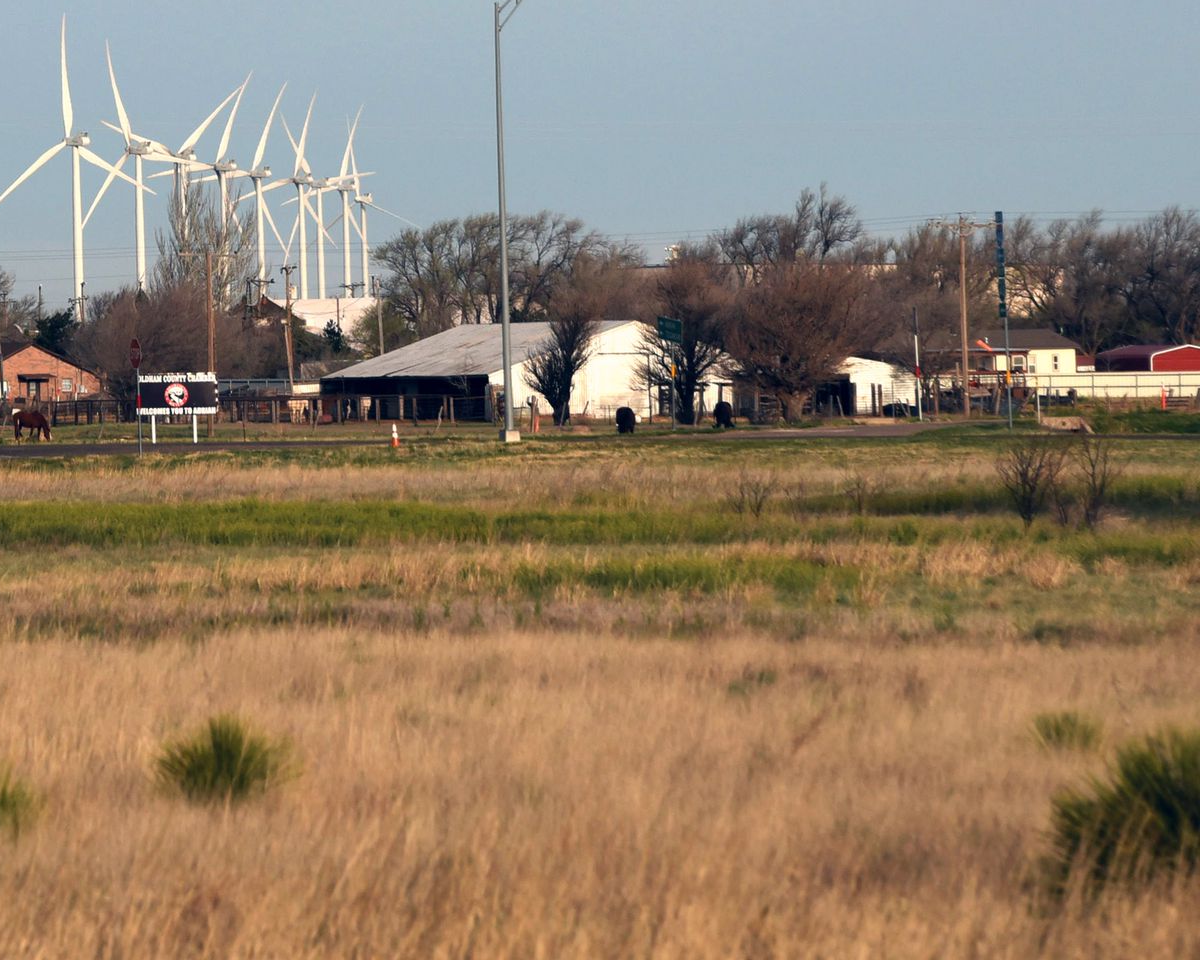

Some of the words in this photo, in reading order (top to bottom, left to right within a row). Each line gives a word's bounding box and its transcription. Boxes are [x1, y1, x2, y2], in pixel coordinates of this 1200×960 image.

[163, 375, 186, 383] COUNTY
[171, 407, 184, 415] YOU
[184, 407, 193, 415] TO
